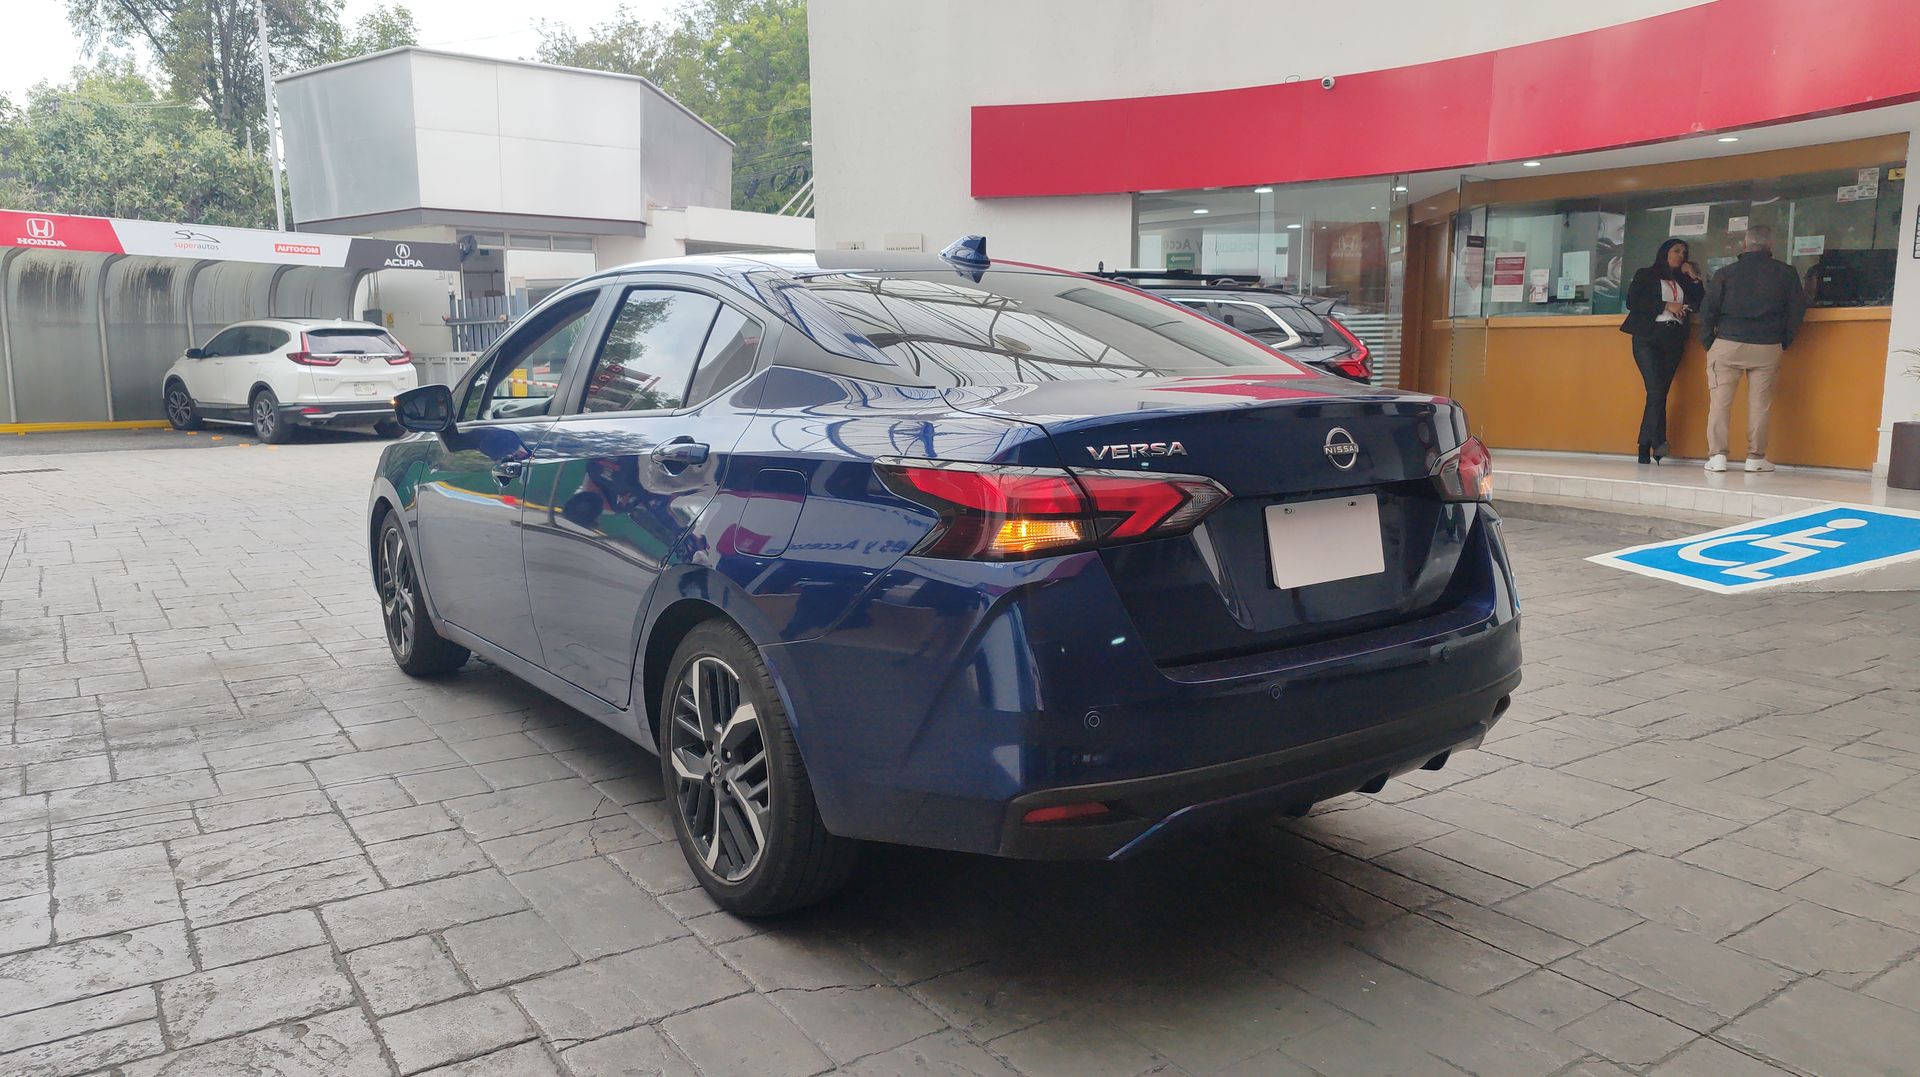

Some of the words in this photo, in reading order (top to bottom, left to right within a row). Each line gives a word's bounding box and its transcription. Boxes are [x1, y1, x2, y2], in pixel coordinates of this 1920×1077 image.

[16, 237, 67, 247] HONDA
[174, 241, 220, 250] superautos
[276, 245, 319, 254] AUTOCOM
[384, 258, 425, 267] ACURA
[1086, 441, 1188, 461] VERSA
[1325, 444, 1358, 455] NISSAN
